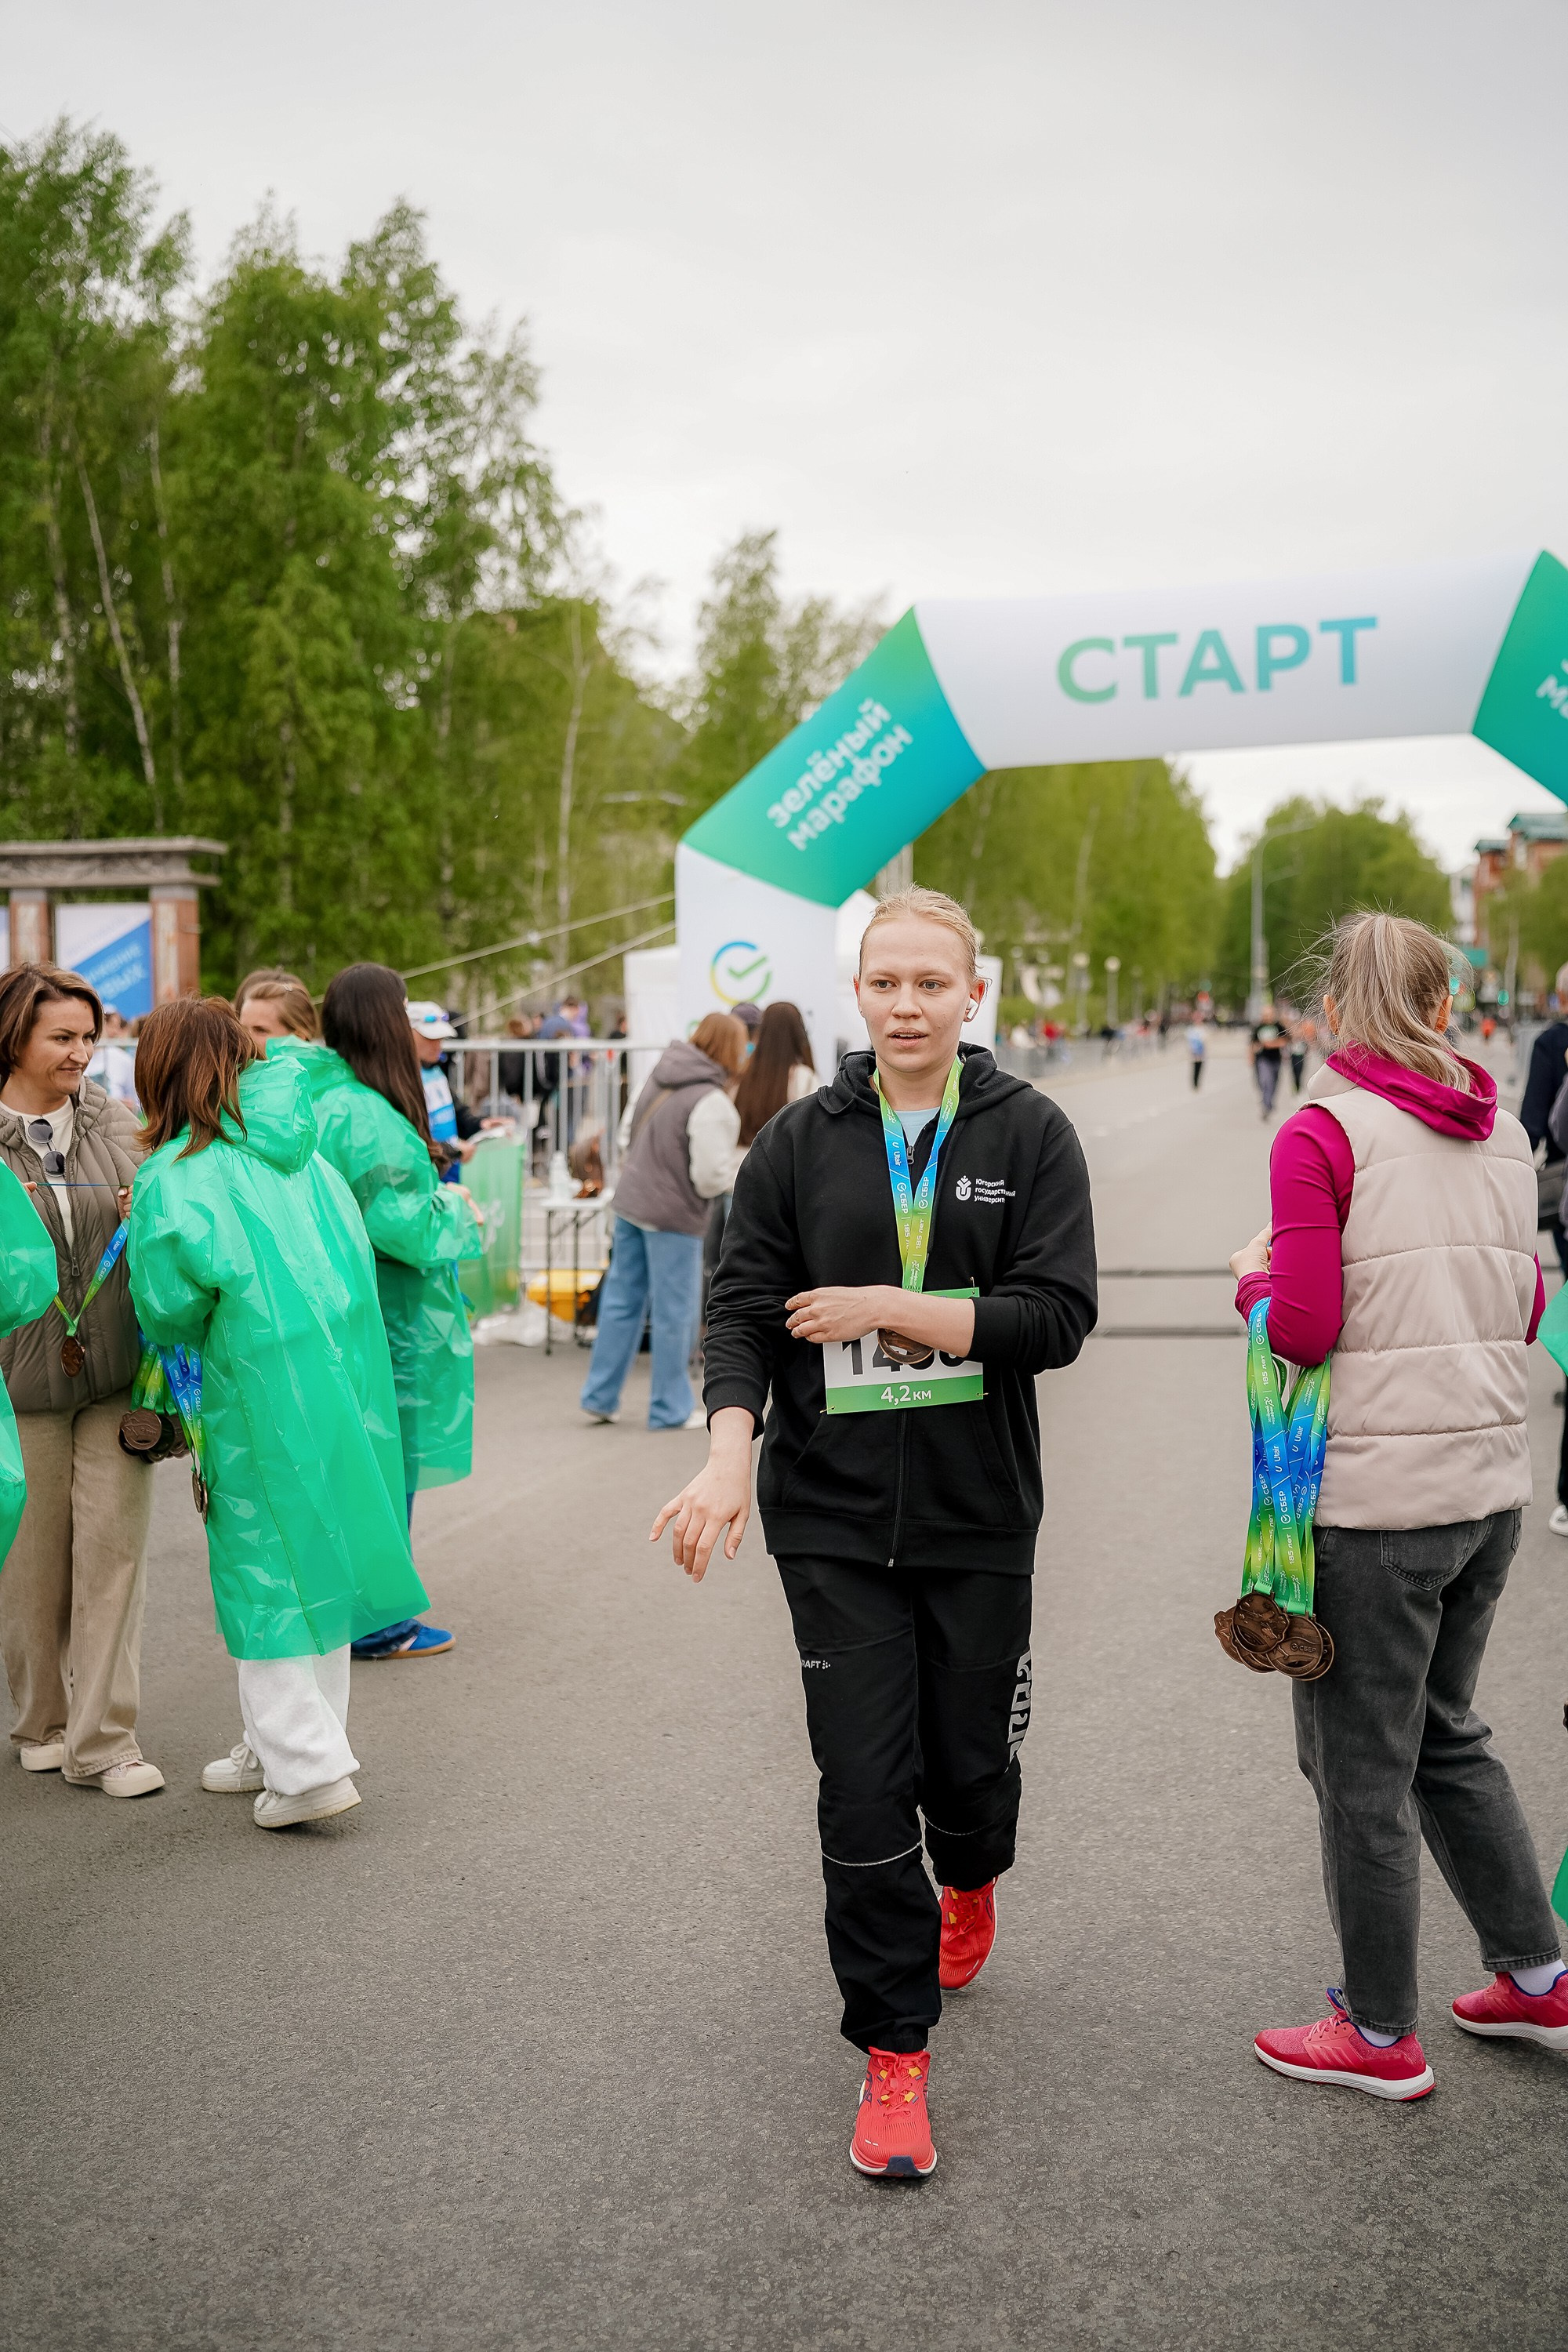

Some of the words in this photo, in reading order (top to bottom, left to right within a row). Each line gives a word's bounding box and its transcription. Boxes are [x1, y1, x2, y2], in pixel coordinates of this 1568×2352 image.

[1056, 615, 1379, 704] СТАРТ
[767, 697, 891, 829] зелёный
[787, 724, 913, 851] марафон
[893, 1151, 902, 1167] Utair
[921, 1176, 930, 1198] СБЕР
[975, 1178, 1004, 1188] Югорский
[975, 1187, 1016, 1197] государстный
[899, 1192, 909, 1214] СБЕР
[1294, 1426, 1303, 1442] Utair
[1272, 1445, 1281, 1462] Utair
[1258, 1473, 1269, 1495] СБЕР
[1279, 1490, 1288, 1513] СБЕР
[1296, 1497, 1305, 1519] СБЕР
[1299, 1645, 1317, 1653] СБЕР
[801, 1659, 821, 1669] RAFT
